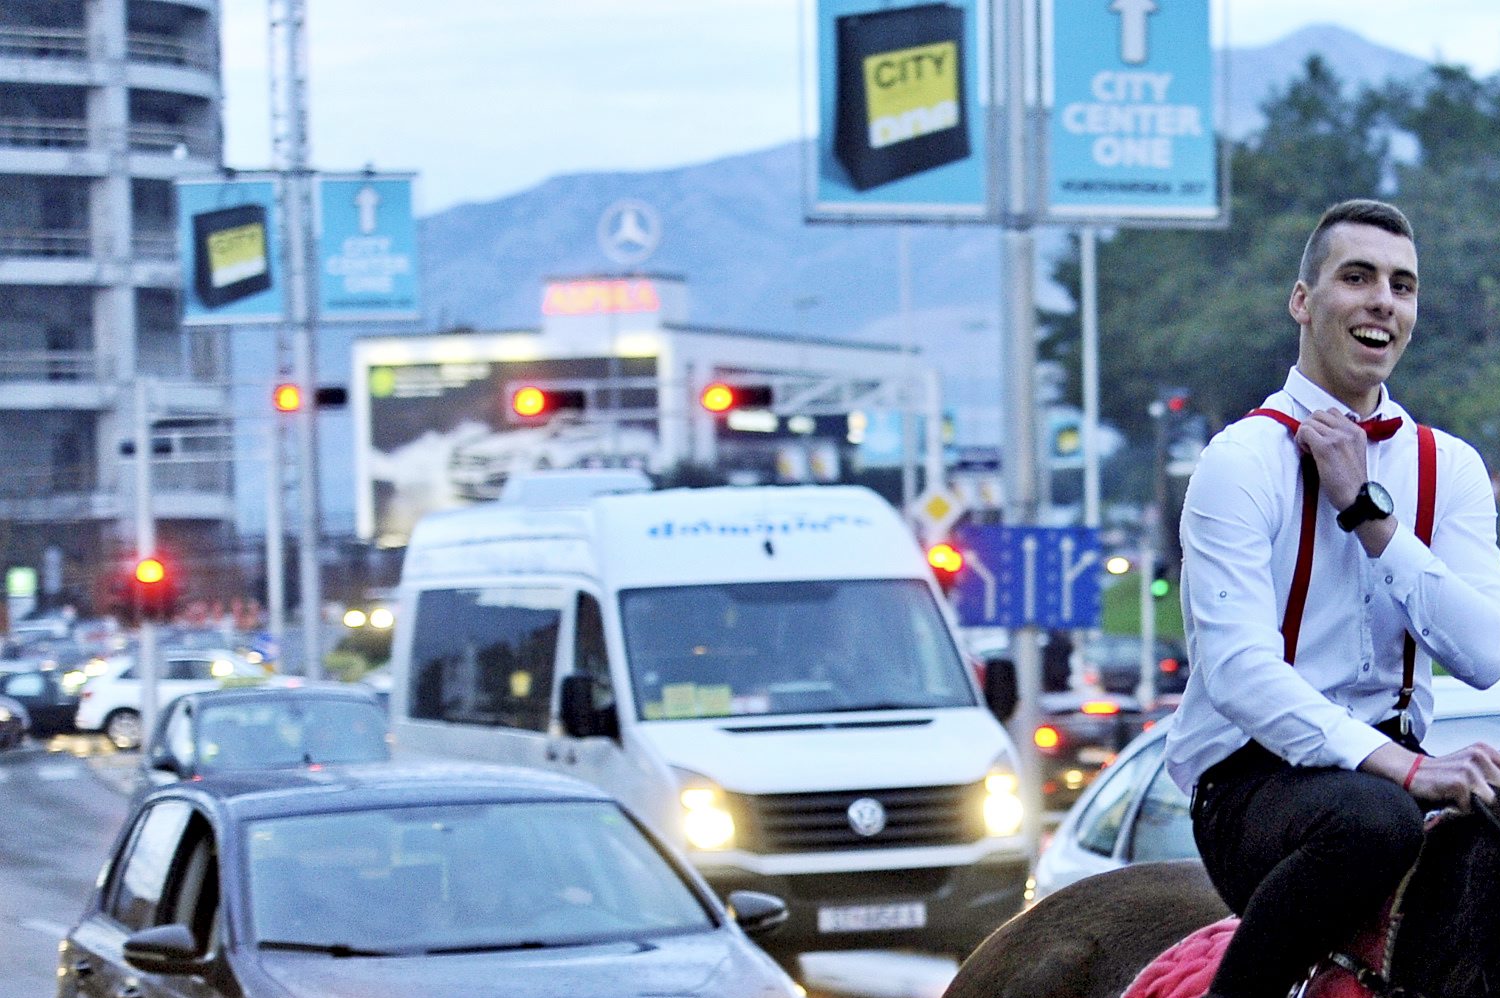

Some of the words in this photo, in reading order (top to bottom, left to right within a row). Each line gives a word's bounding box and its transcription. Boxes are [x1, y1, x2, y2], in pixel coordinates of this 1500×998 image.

[874, 49, 948, 89] CITY
[1091, 71, 1173, 102] CITY
[868, 100, 959, 148] one
[1062, 103, 1201, 135] CENTER
[1091, 137, 1173, 168] ONE
